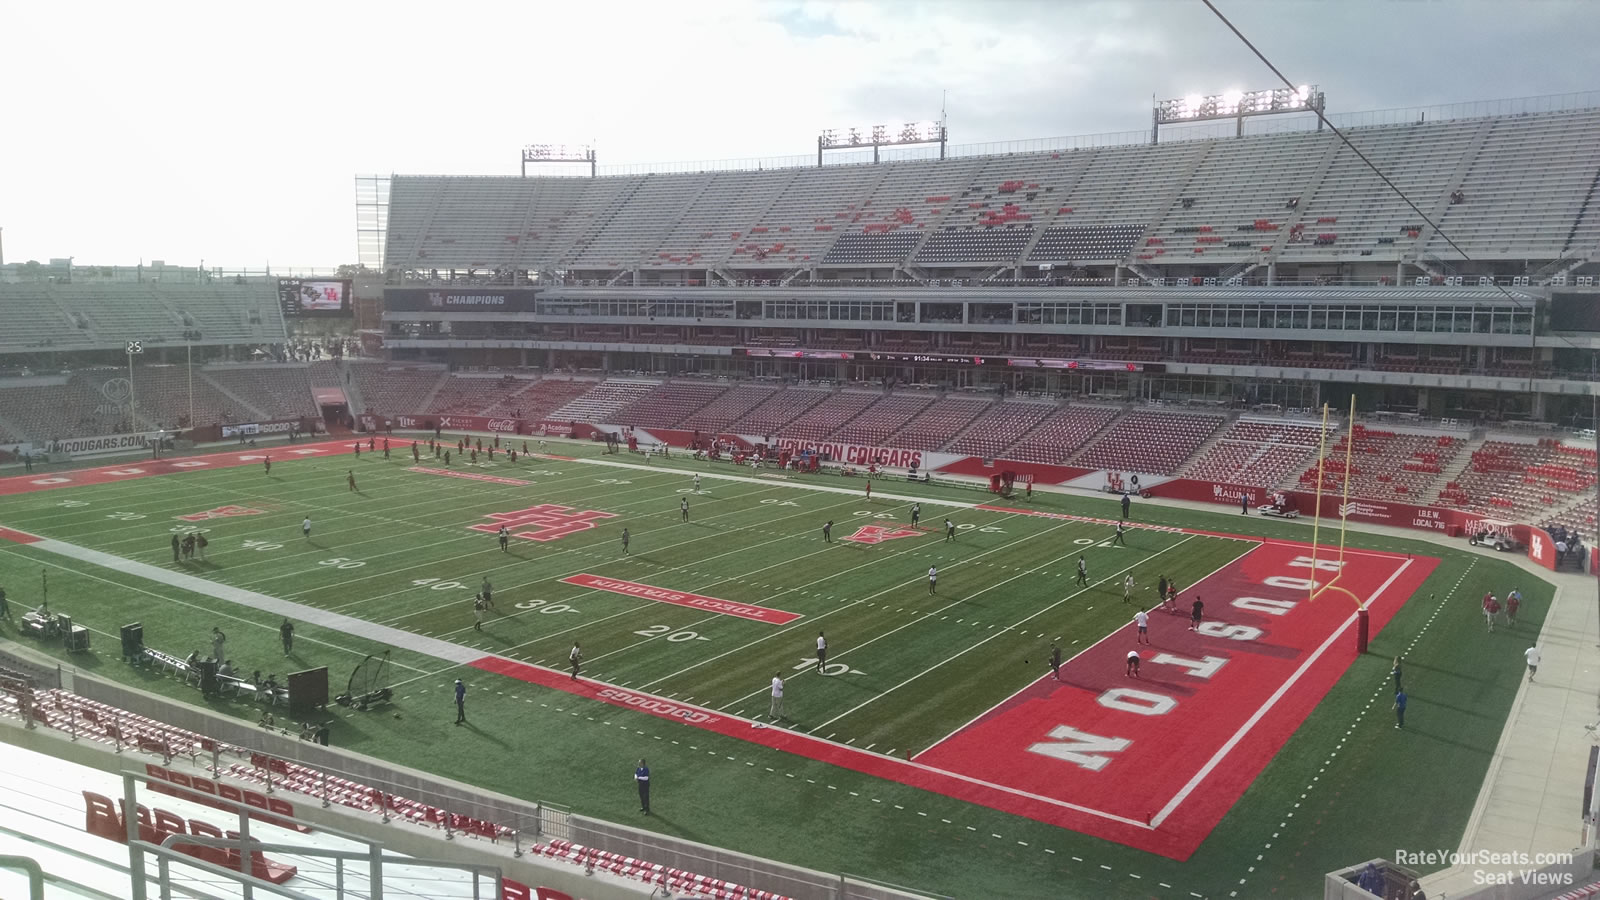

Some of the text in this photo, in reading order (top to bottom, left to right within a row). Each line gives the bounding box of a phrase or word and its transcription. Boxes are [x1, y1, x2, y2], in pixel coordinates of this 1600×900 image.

[446, 296, 505, 304] CHAMPIONS
[128, 341, 142, 352] 25
[398, 416, 416, 428] Lite
[547, 424, 572, 433] Academy
[846, 446, 922, 469] COUGARS
[1107, 472, 1124, 491] UH
[467, 504, 620, 542] UH
[1412, 518, 1445, 529] LOCAL 716
[1464, 520, 1513, 536] MEMORIAL
[1532, 534, 1542, 560] UH
[318, 557, 366, 569] 50
[411, 577, 461, 590] 40
[588, 578, 766, 618] TDECU STADIUM
[514, 599, 570, 614] 30
[633, 624, 698, 642] 20
[792, 658, 850, 676] 10
[1025, 555, 1346, 772] HOUSTON
